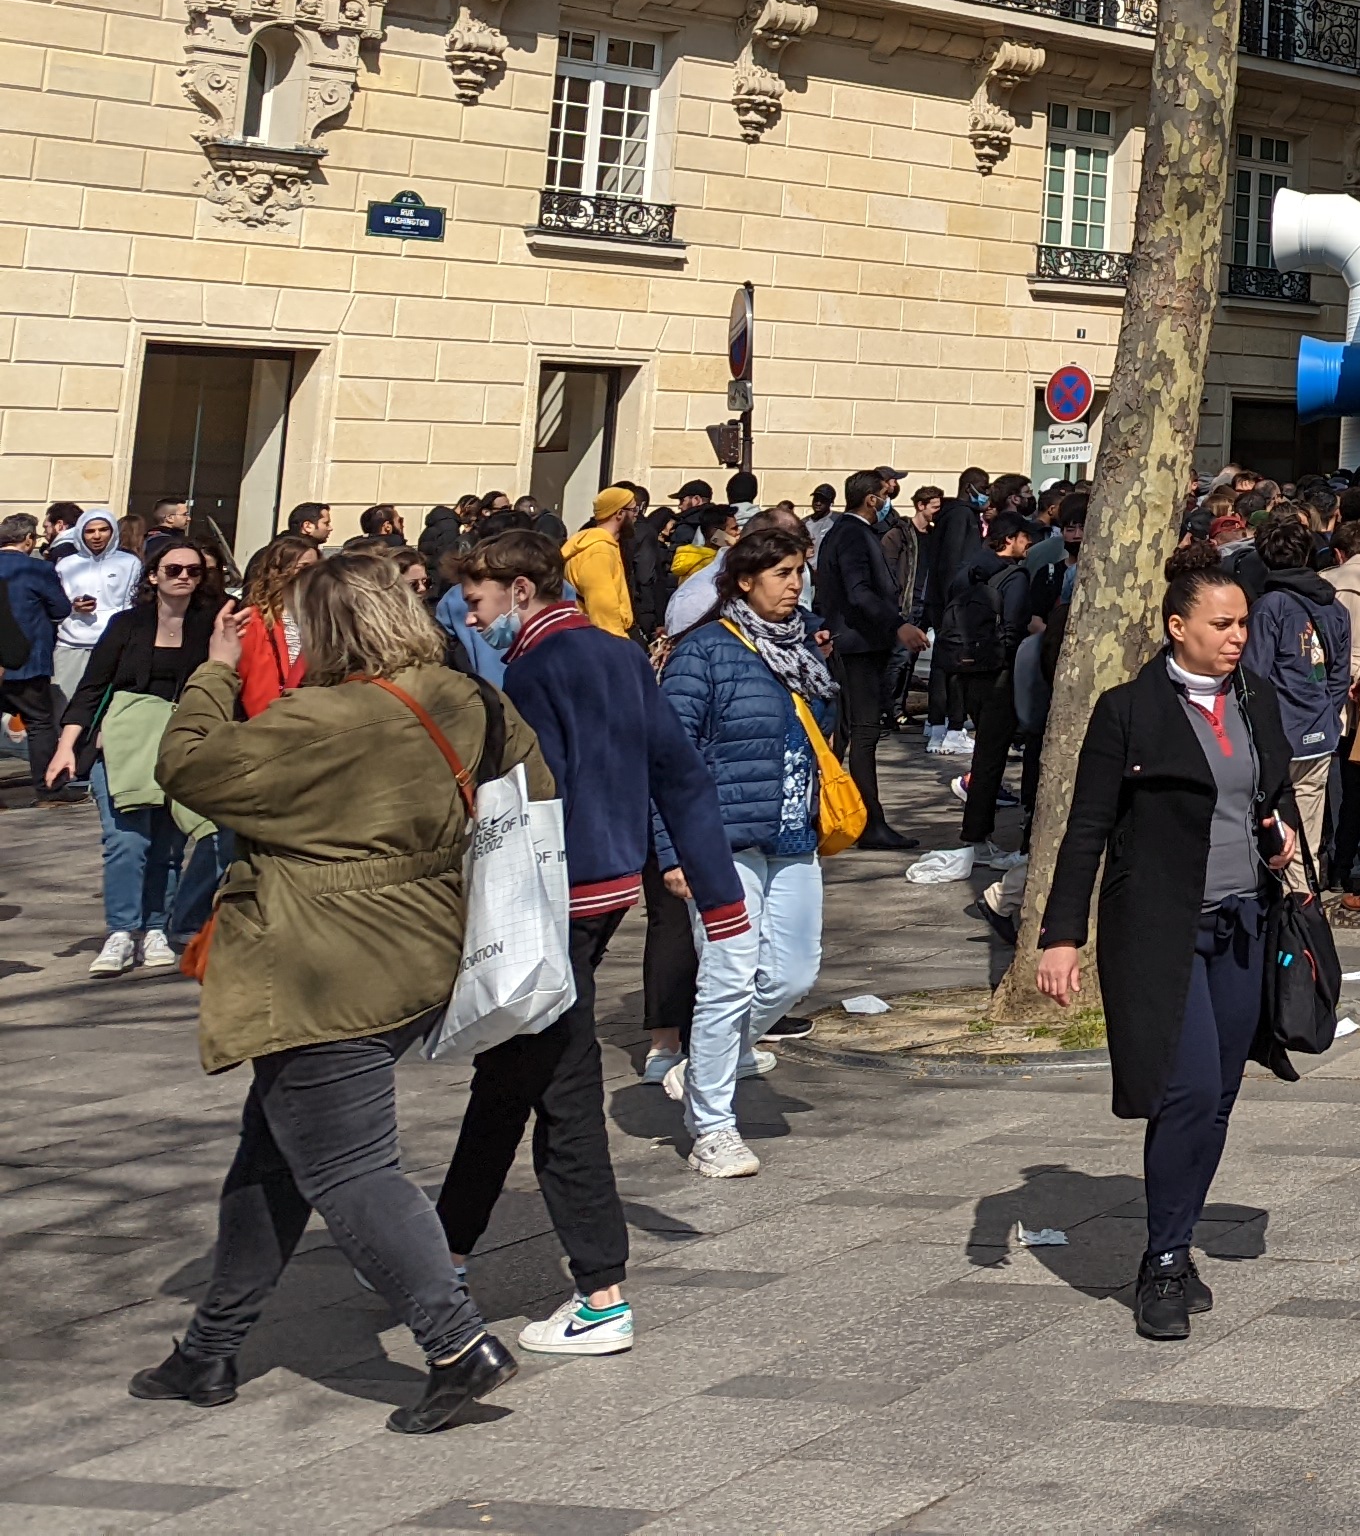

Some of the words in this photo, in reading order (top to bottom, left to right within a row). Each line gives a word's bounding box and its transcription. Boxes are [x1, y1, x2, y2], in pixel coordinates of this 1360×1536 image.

[400, 208, 415, 217] RUE
[384, 216, 430, 227] WASHINGTON
[501, 816, 518, 834] OF
